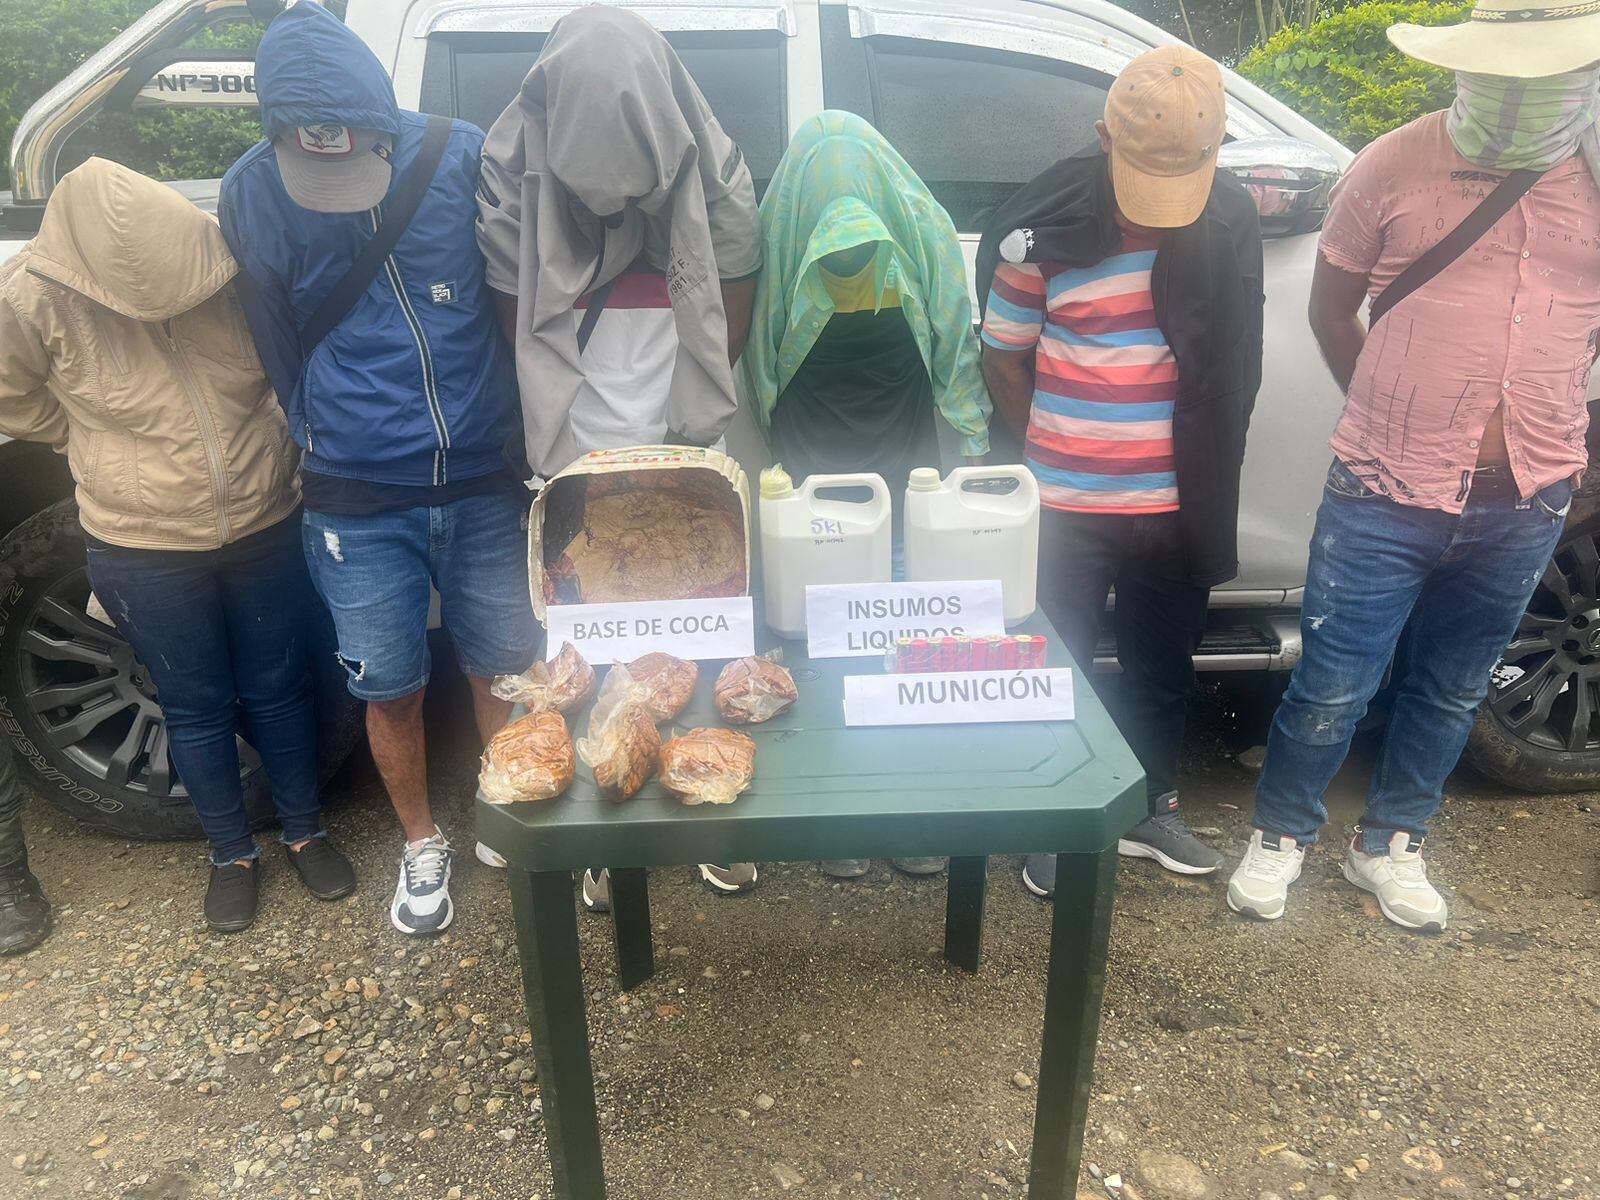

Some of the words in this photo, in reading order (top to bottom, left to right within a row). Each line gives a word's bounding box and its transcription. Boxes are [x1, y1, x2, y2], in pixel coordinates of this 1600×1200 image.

[848, 596, 962, 619] INSUMOS
[573, 620, 628, 640] BASE
[635, 618, 662, 636] DE
[669, 615, 729, 635] COCA
[897, 670, 1052, 705] MUNICIÓN
